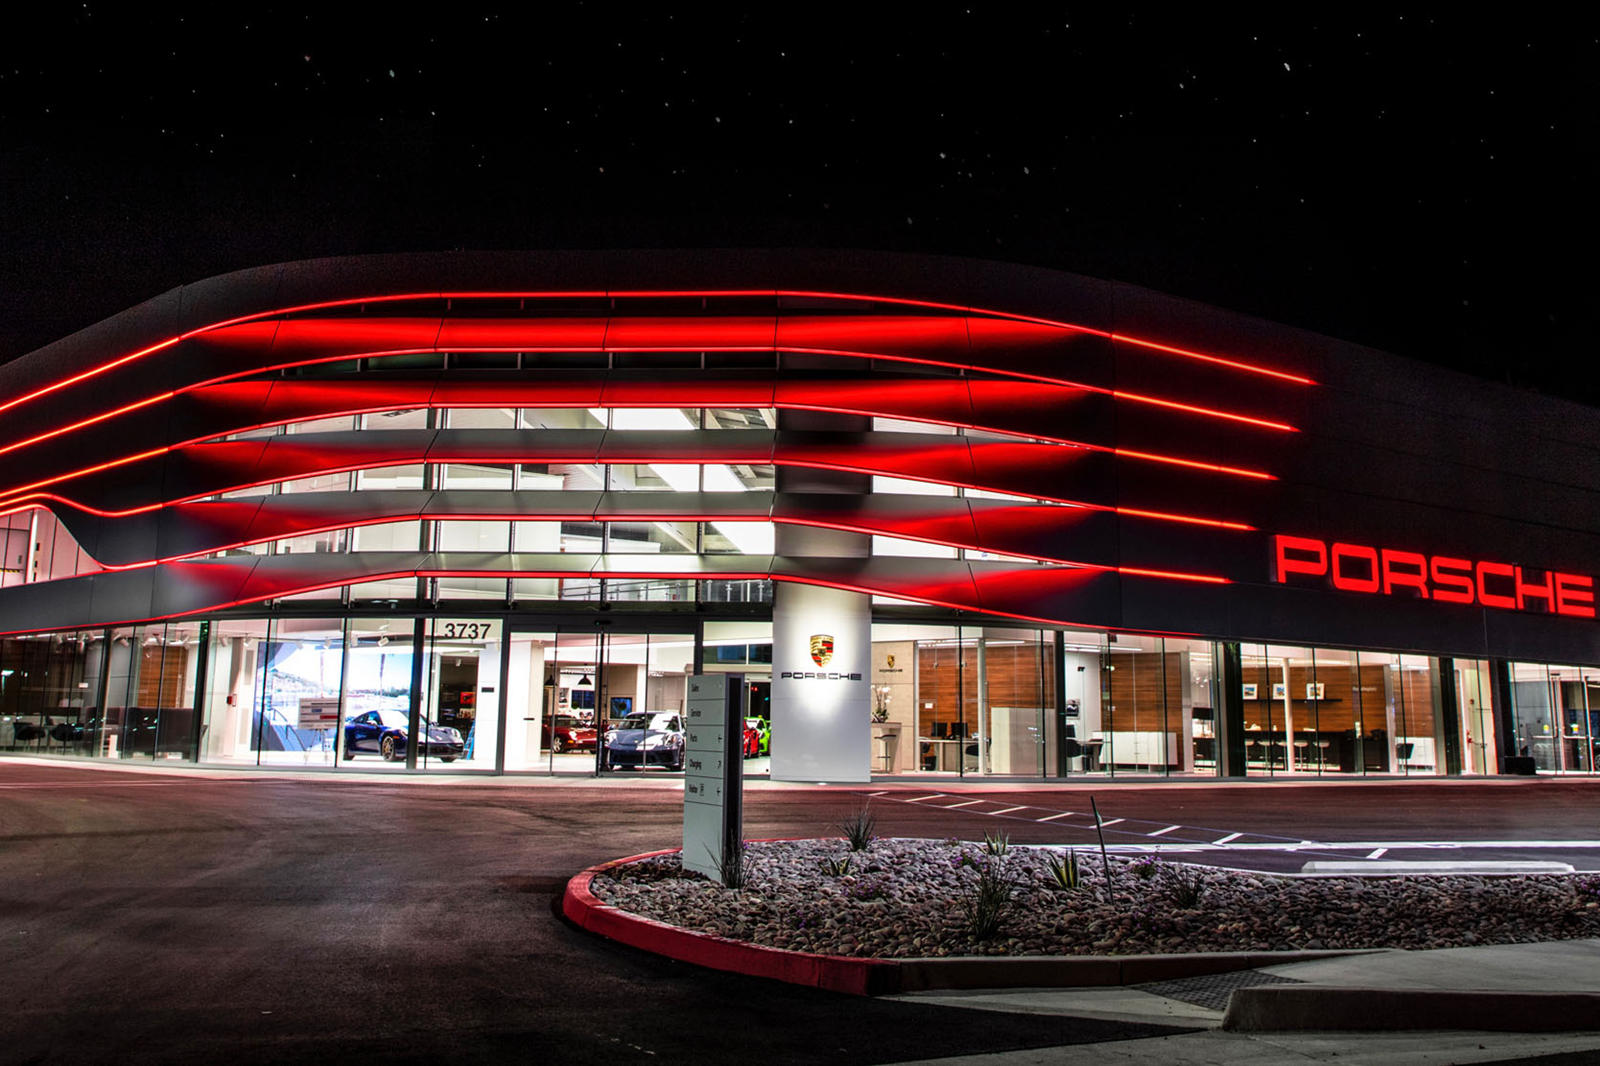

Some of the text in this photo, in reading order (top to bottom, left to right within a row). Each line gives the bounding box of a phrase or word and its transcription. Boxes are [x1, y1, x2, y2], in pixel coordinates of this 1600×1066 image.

[1275, 534, 1596, 618] PORSCHE
[444, 623, 491, 640] 3737
[781, 672, 861, 680] PORSCHE
